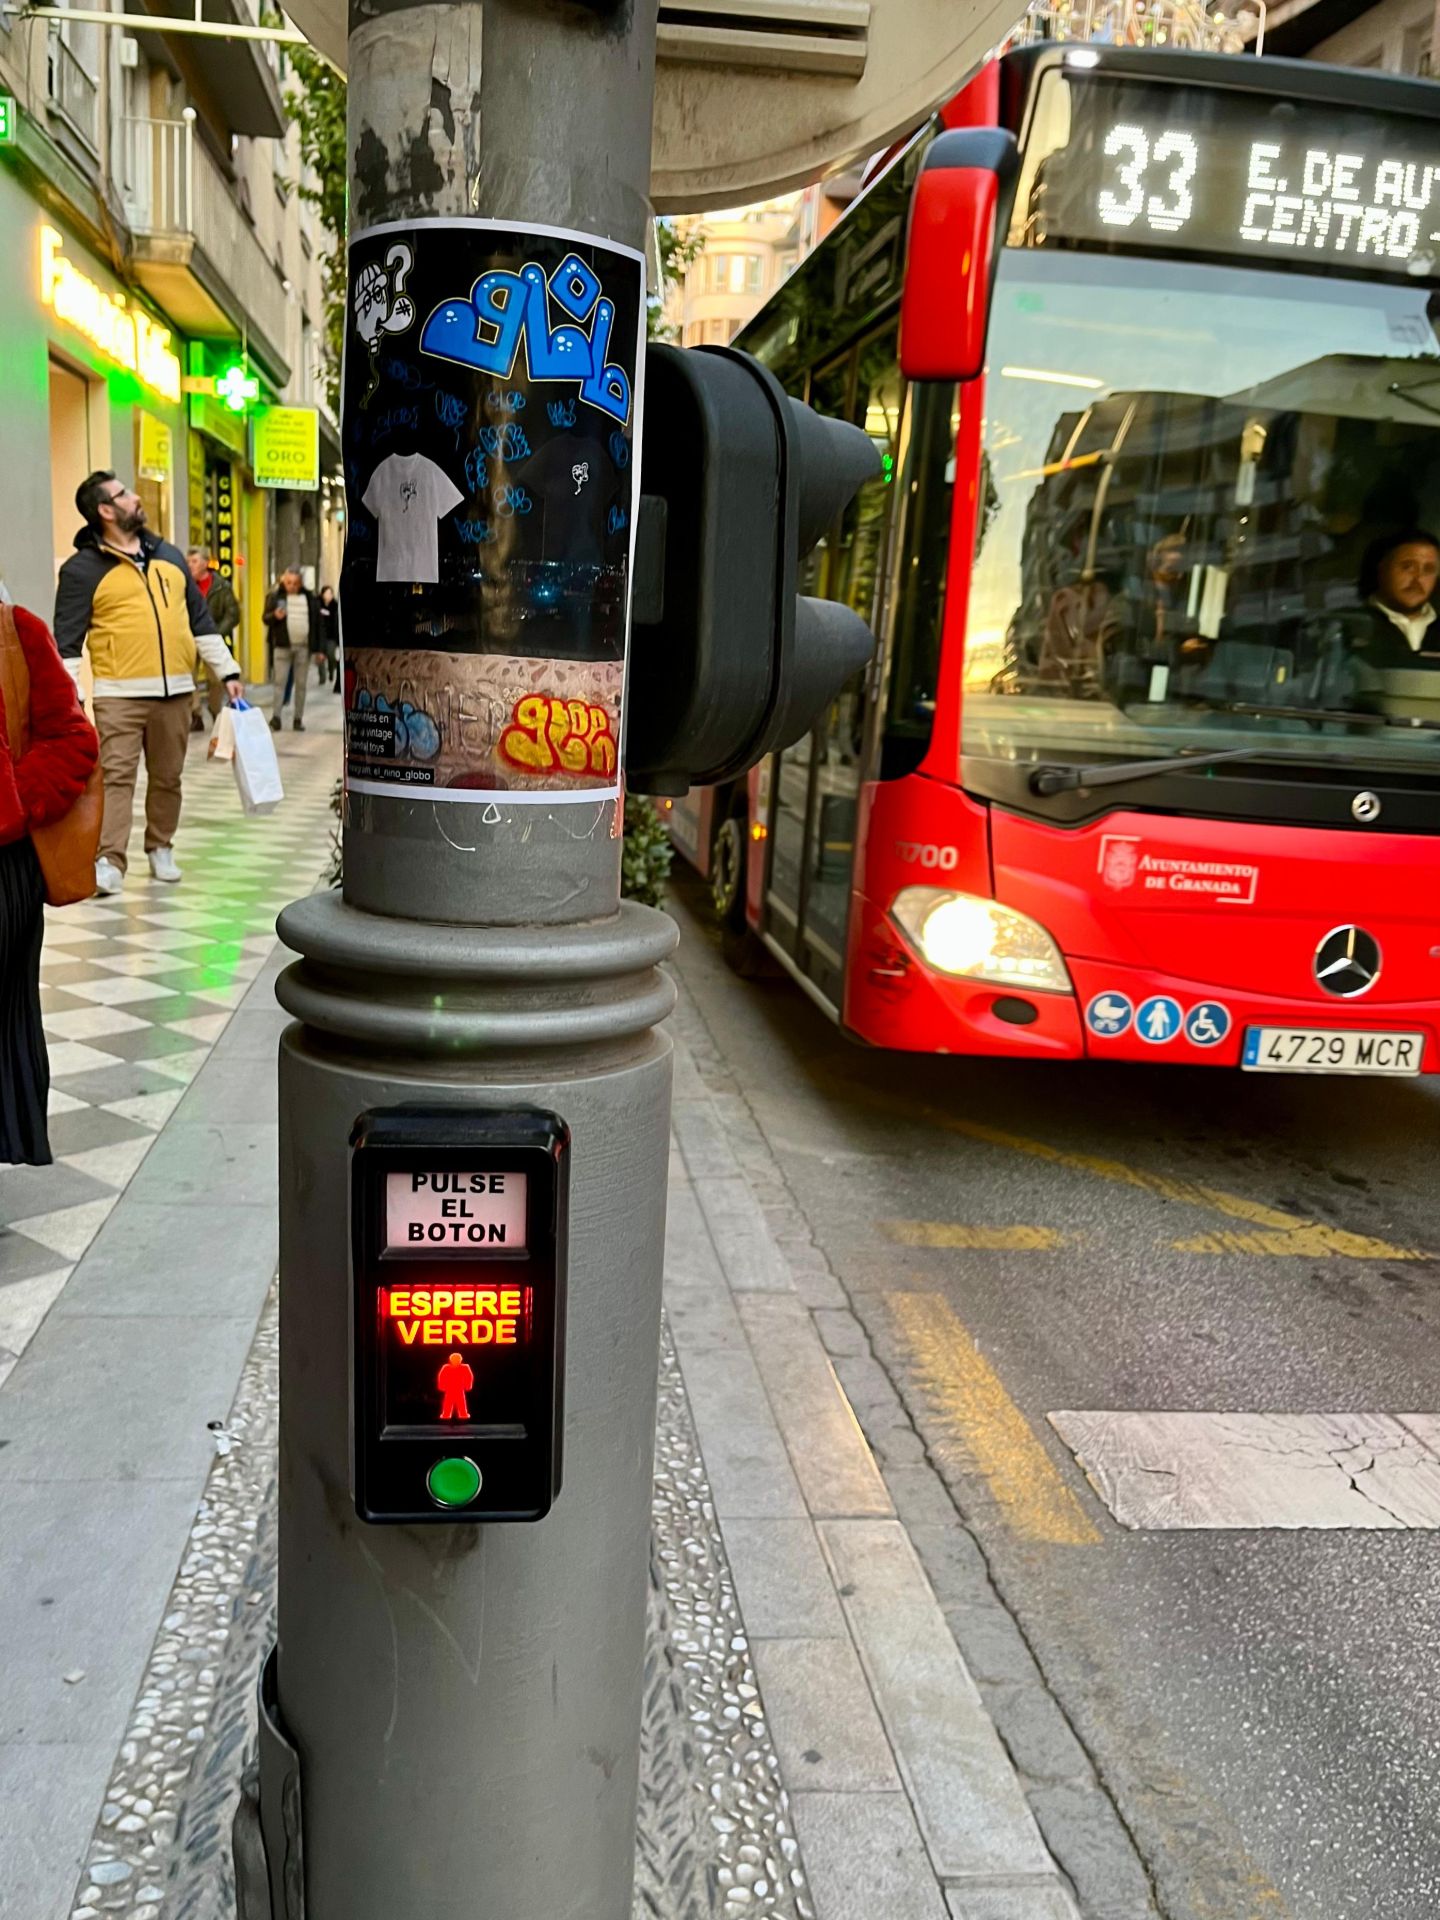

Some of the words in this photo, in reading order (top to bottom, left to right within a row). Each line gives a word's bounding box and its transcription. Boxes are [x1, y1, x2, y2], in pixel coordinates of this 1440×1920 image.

[1100, 124, 1198, 232] 33
[1248, 142, 1287, 192] E.
[1302, 150, 1364, 201] DE
[1239, 192, 1420, 258] CENTRO
[218, 475, 232, 578] COMPRO
[379, 715, 389, 723] en
[1267, 1035, 1345, 1064] 4729
[1355, 1038, 1413, 1067] MCR
[411, 1173, 505, 1194] PULSE
[441, 1199, 473, 1218] EL
[408, 1223, 506, 1243] BOTON
[389, 1290, 521, 1316] ESPERE
[397, 1319, 517, 1344] VERDE
